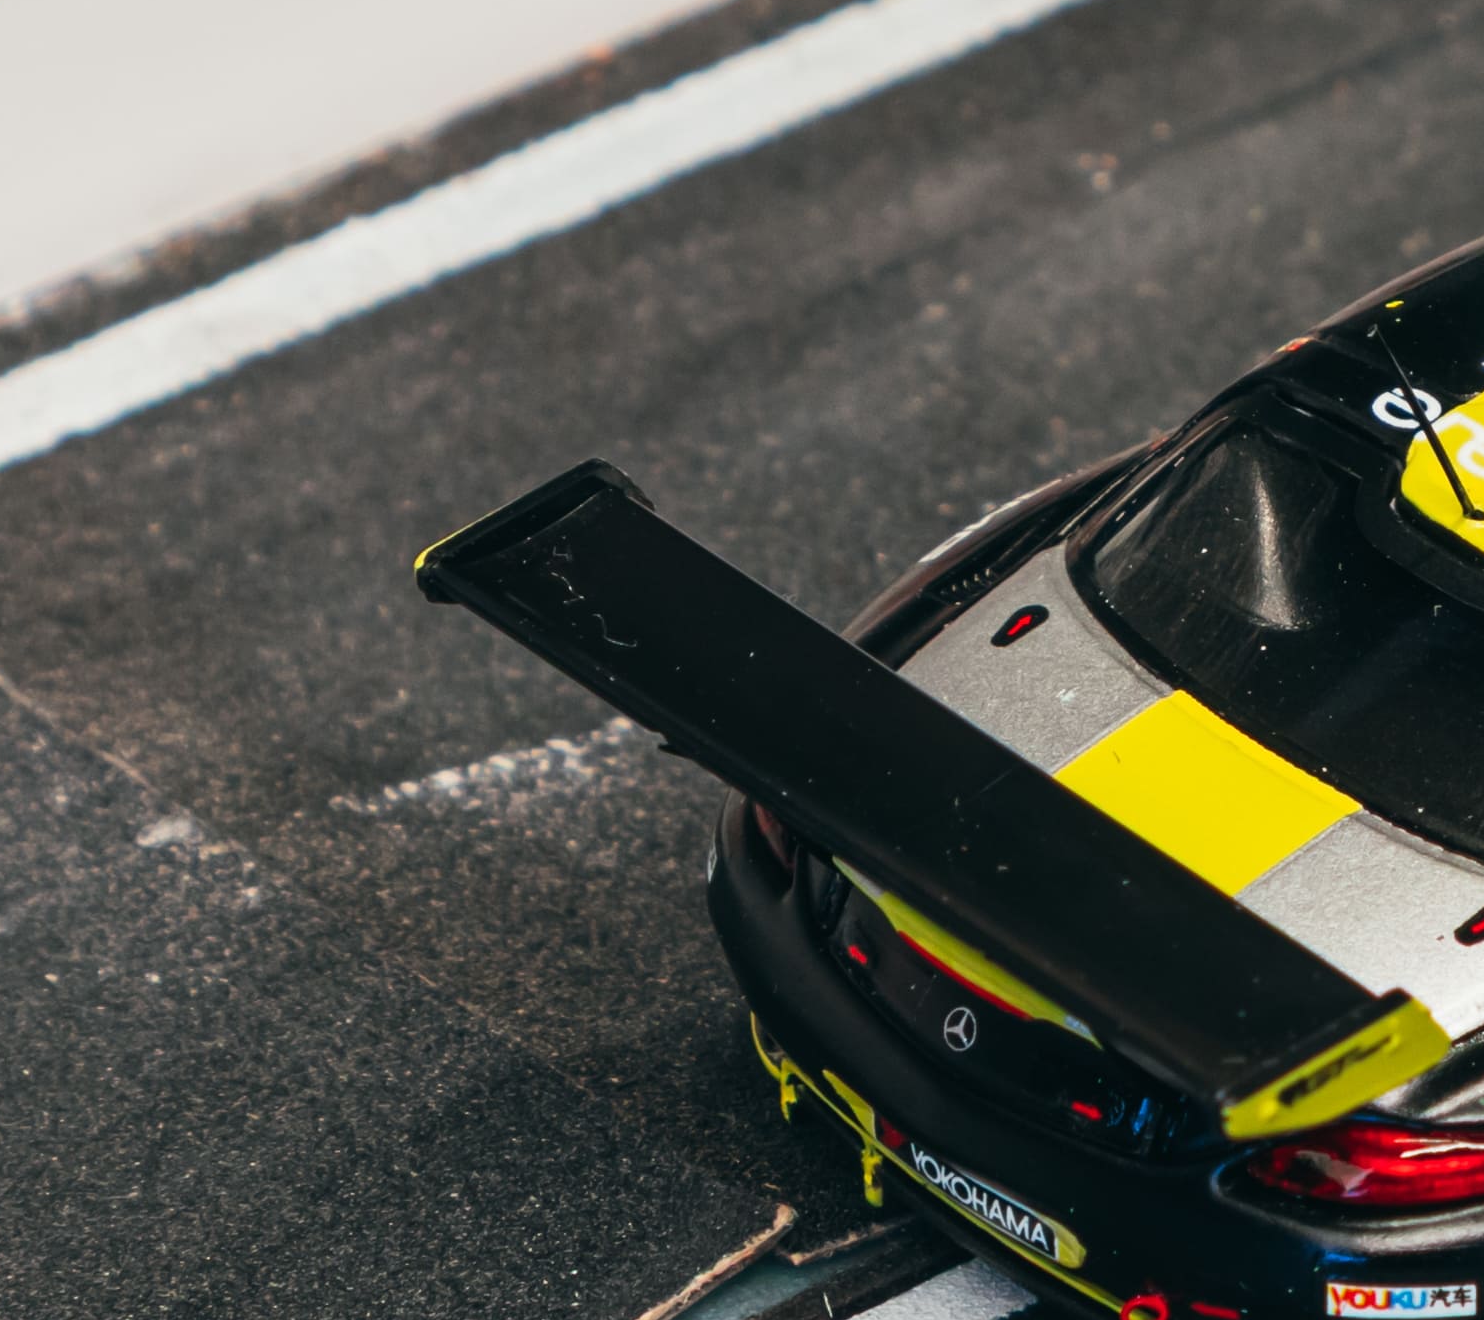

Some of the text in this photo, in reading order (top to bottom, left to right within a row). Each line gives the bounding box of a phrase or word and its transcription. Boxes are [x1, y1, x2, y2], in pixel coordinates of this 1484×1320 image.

[910, 1142, 1050, 1251] YOKOHAMA
[1330, 1285, 1473, 1317] YOUKU 汽车
